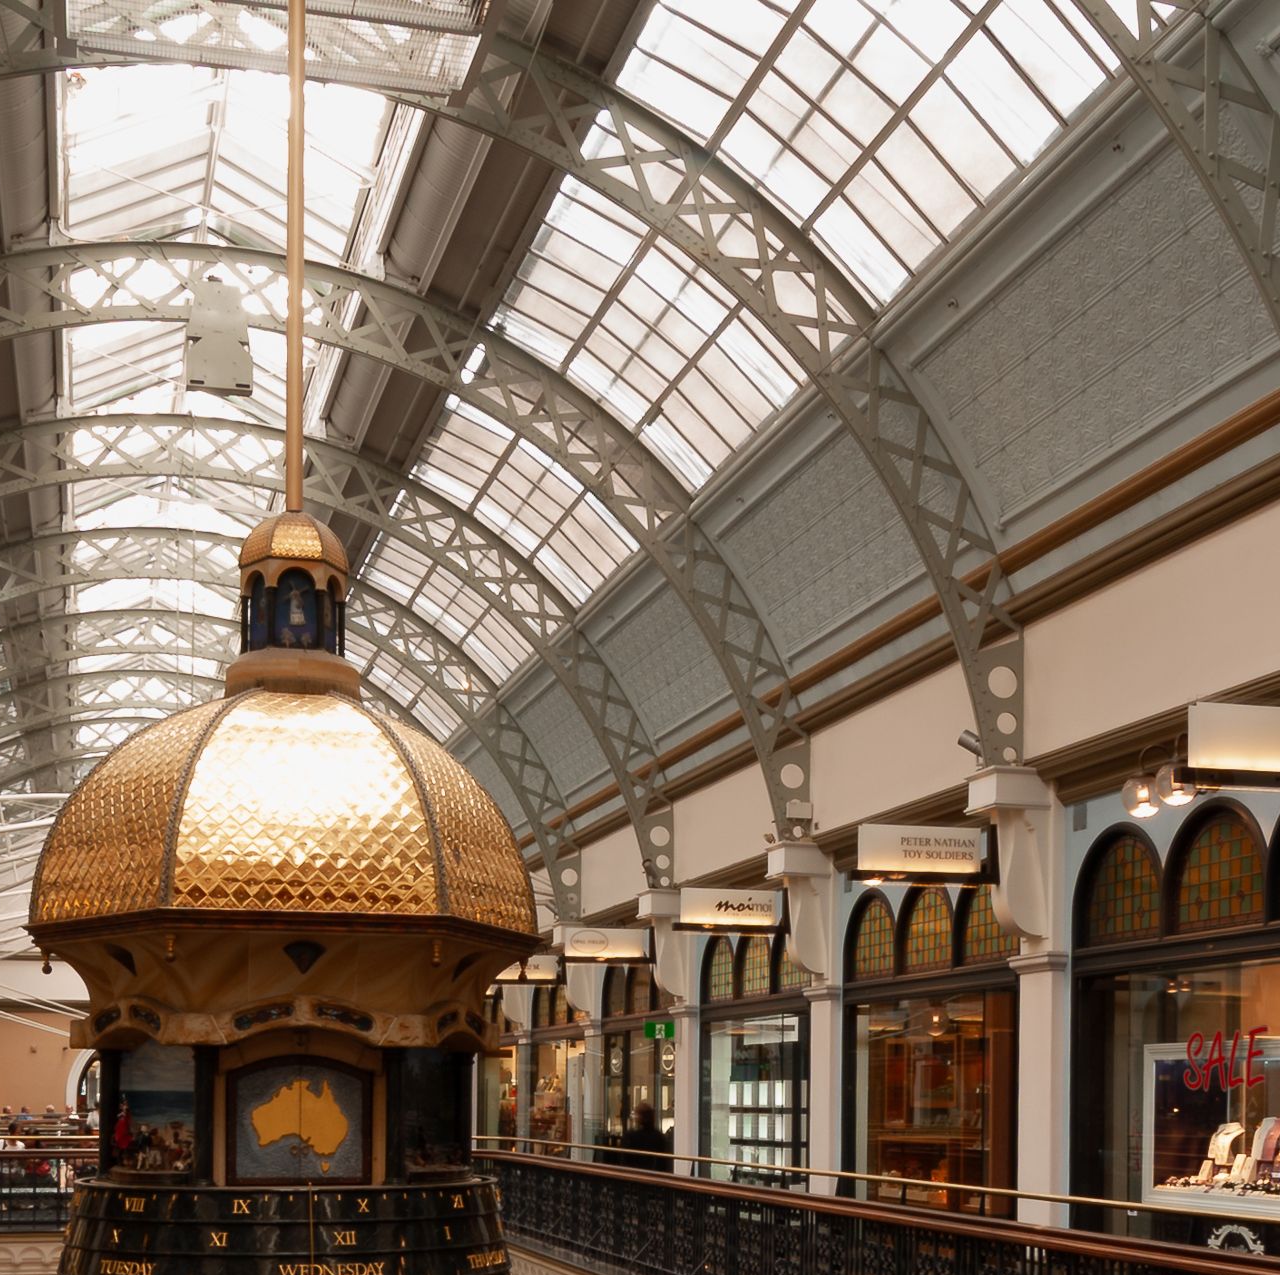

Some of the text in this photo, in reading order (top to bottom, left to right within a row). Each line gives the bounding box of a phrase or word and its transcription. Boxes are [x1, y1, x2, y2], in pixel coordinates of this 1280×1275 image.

[900, 837, 975, 848] PETER NATHAN
[902, 849, 974, 860] TOY SOLDIERS
[1183, 1026, 1268, 1092] SALE
[124, 1198, 146, 1213] VIII
[232, 1199, 252, 1214] IX
[357, 1198, 370, 1213] X
[209, 1232, 228, 1247] XI
[333, 1230, 357, 1246] XII
